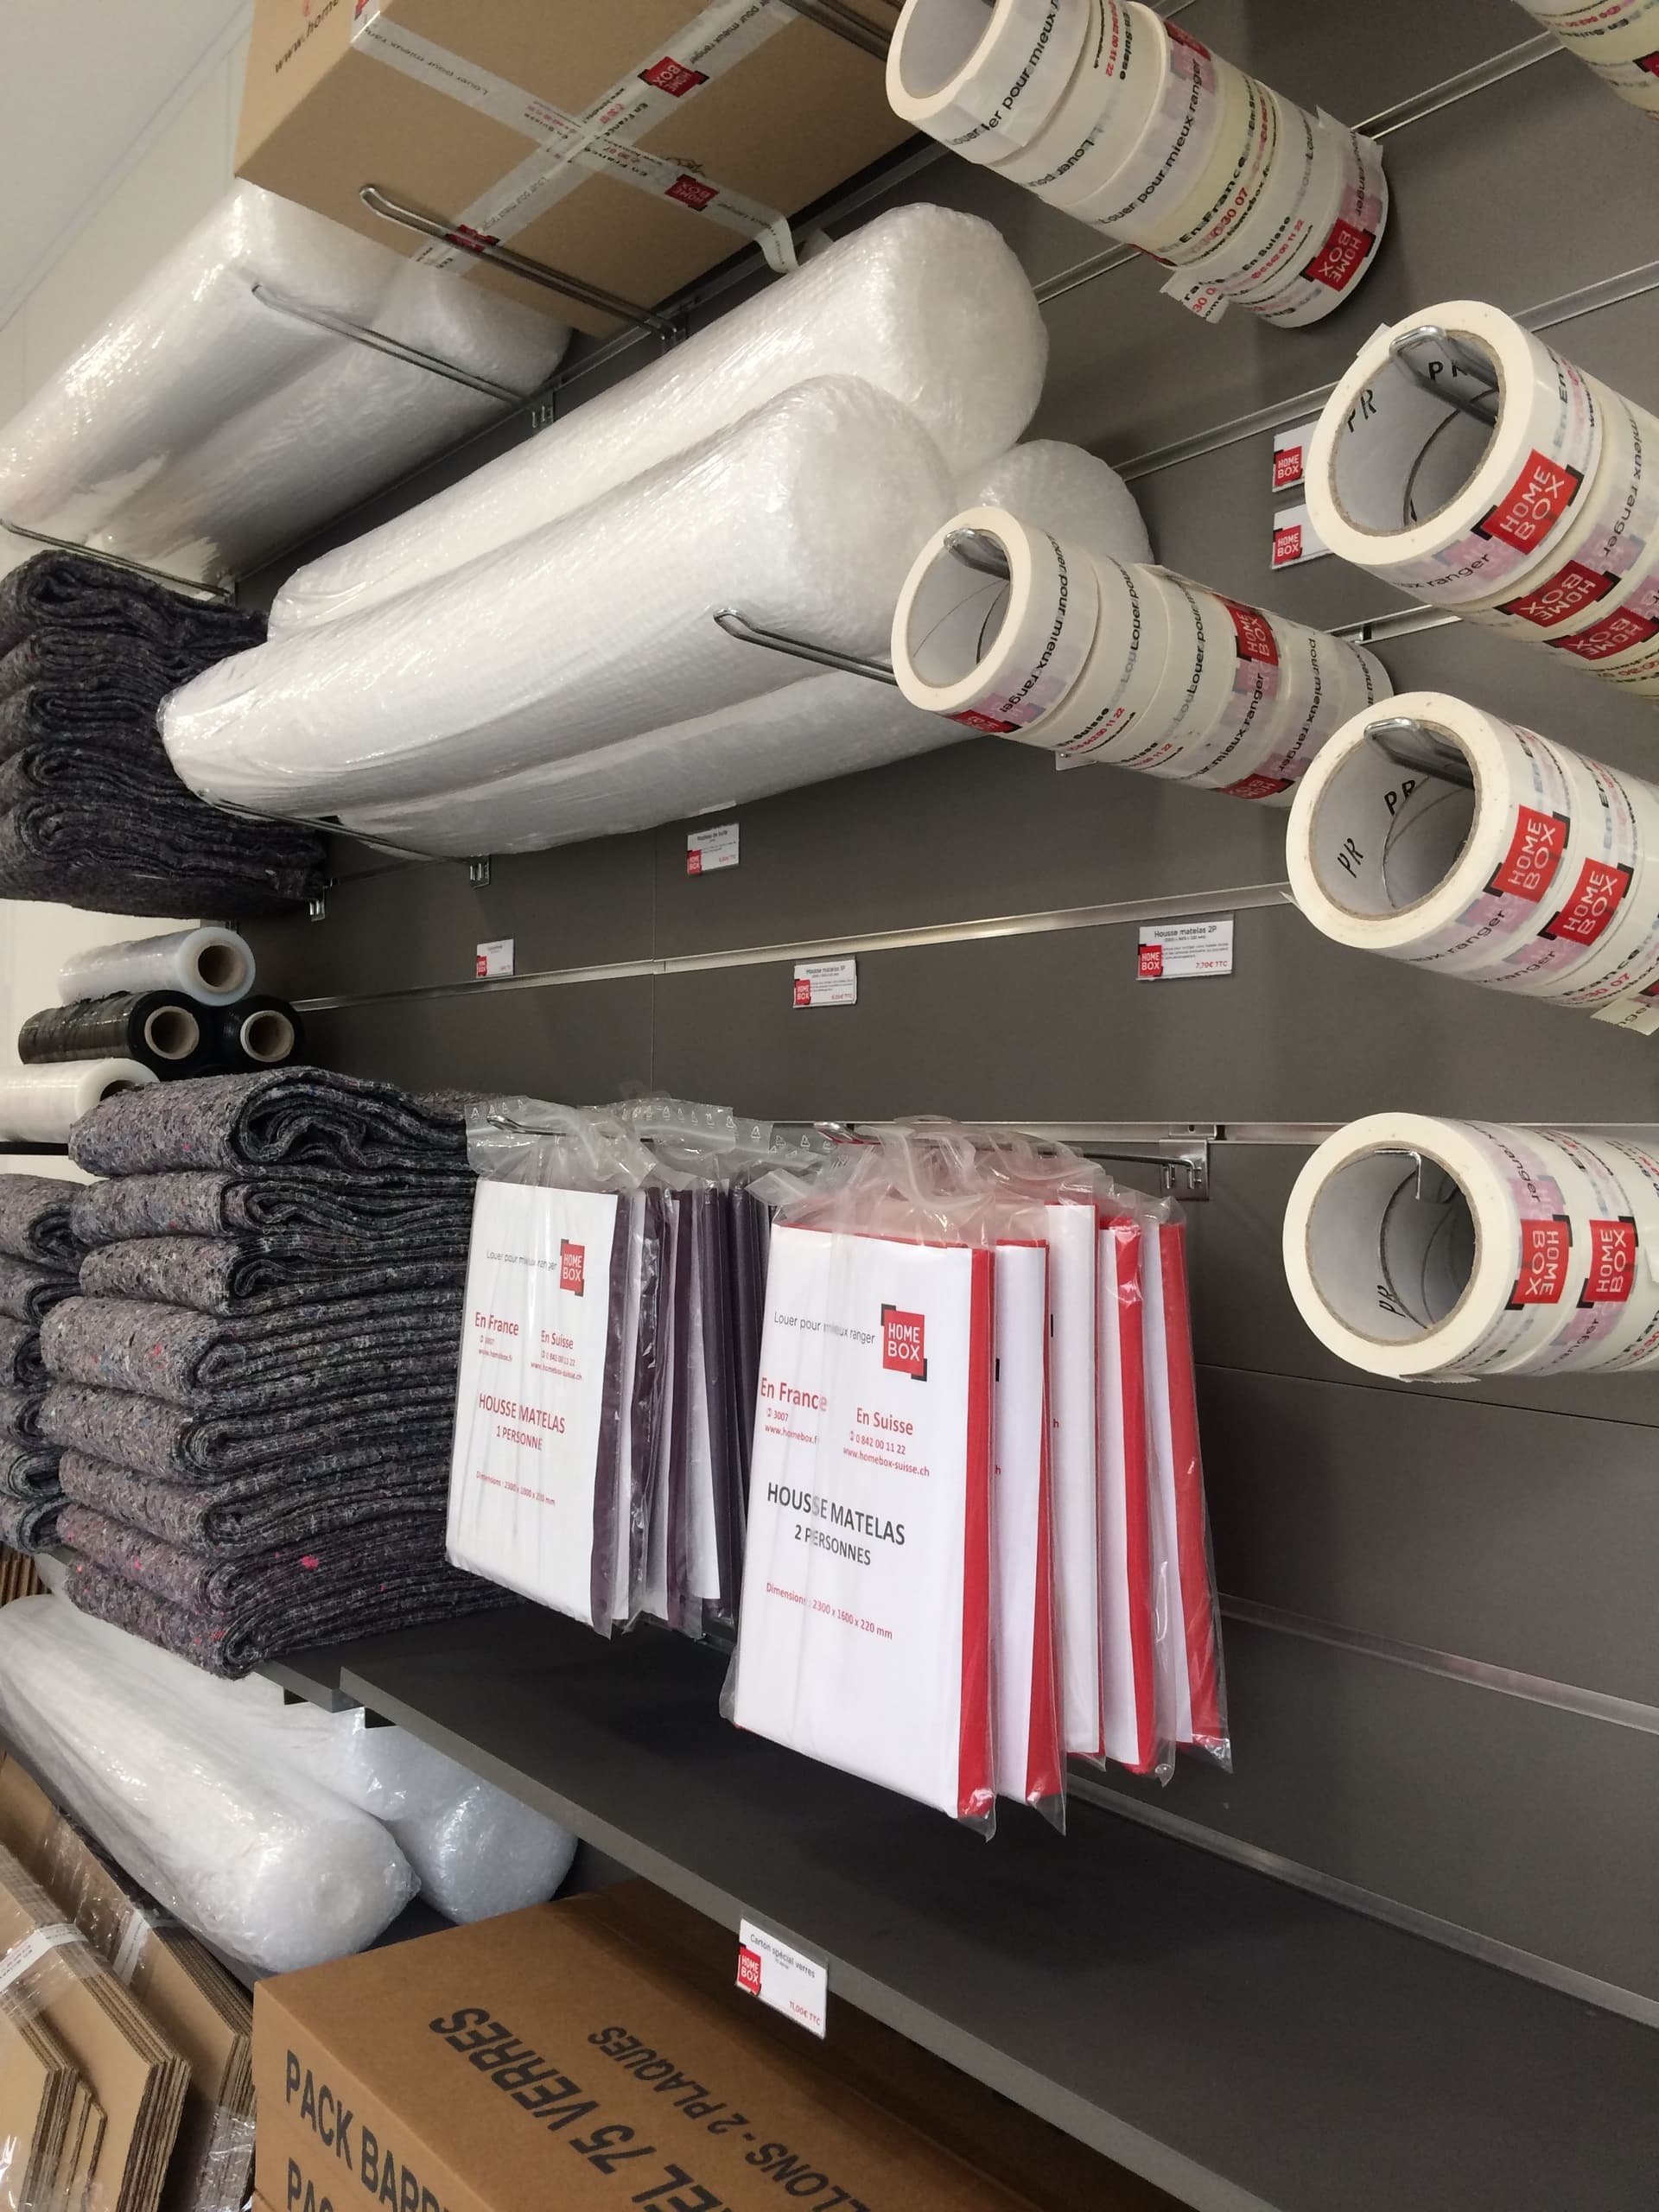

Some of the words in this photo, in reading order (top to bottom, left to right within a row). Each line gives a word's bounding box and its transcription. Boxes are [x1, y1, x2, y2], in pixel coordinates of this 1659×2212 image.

[1002, 67, 1030, 110] pour
[1028, 12, 1056, 67] mieux
[1137, 169, 1166, 204] pour
[1166, 115, 1194, 168] mieux
[1189, 58, 1204, 113] ranger
[1235, 187, 1249, 206] 07
[1317, 230, 1353, 278] BOX
[1332, 238, 1363, 283] HOME
[1278, 454, 1300, 470] HOME
[1278, 464, 1300, 480] BOX
[1500, 465, 1552, 532] HOME
[1515, 474, 1565, 542] BOX
[1277, 533, 1300, 548] HOME
[1603, 486, 1639, 557] ranger
[1277, 542, 1300, 556] BOX
[1427, 552, 1491, 588] ranger
[1058, 574, 1069, 617] pour
[1519, 573, 1580, 615] BOX
[1534, 579, 1596, 622] HOME
[1037, 619, 1064, 671] mieux
[1131, 601, 1141, 651] Louer
[1236, 613, 1260, 653] HOME
[1252, 616, 1271, 658] BOX
[1567, 618, 1631, 650] BOX
[1584, 624, 1644, 656] HOME
[1186, 646, 1205, 695] Louer
[1210, 729, 1247, 768] mieux
[1244, 673, 1263, 725] ranger
[1306, 677, 1323, 723] mieux
[1279, 728, 1309, 772] ranger
[1509, 818, 1543, 887] HOME
[1522, 823, 1557, 892] BOX
[1563, 870, 1607, 931] HOME
[1578, 877, 1618, 937] BOX
[1179, 926, 1206, 936] matelas
[1447, 909, 1507, 956] ranger
[1141, 952, 1160, 962] HOME
[1141, 961, 1161, 971] BOX
[1497, 1142, 1541, 1203] ranger
[563, 1254, 583, 1268] HOME
[563, 1268, 582, 1281] BOX
[1524, 1230, 1546, 1296] BOX
[1540, 1230, 1559, 1296] HOME
[1596, 1229, 1613, 1293] HOME
[1609, 1230, 1626, 1293] BOX
[475, 1312, 486, 1328] En
[488, 1314, 518, 1336] France
[541, 1330, 550, 1343] En
[551, 1332, 574, 1350] Suisse
[774, 1312, 798, 1327] Louer
[800, 1318, 821, 1332] pour
[849, 1328, 876, 1344] ranger
[887, 1322, 920, 1344] HOME
[887, 1340, 920, 1362] BOX
[480, 1393, 517, 1419] HOUSSE
[518, 1404, 566, 1434] MATELAS
[760, 1377, 774, 1398] En
[779, 1382, 828, 1411] France
[773, 1410, 789, 1422] 3007
[856, 1407, 869, 1426] En
[874, 1412, 913, 1436] Suisse
[496, 1425, 501, 1437] 1
[503, 1427, 543, 1451] PERSONNE
[861, 1435, 874, 1447] 842
[875, 1439, 884, 1450] 00
[886, 1441, 894, 1452] 11
[896, 1445, 906, 1455] 22
[842, 1446, 930, 1477] www.homebox-suisse.ch
[767, 1482, 829, 1519] HOUSSE
[830, 1502, 906, 1546] MATELAS
[794, 1524, 802, 1541] 2
[804, 1527, 871, 1566] PERSONNES
[812, 1599, 830, 1615] 2300
[861, 1618, 875, 1633] 220
[876, 1627, 893, 1640] mm
[741, 1955, 760, 1974] HOME
[741, 1966, 759, 1985] BOX
[750, 1934, 771, 1952] Carton
[772, 1947, 794, 1964] spécial
[795, 1961, 815, 1978] verres
[809, 2013, 821, 2025] TTC
[429, 2007, 600, 2133] VERRES
[587, 2025, 727, 2120] PLAQUES
[286, 2049, 353, 2171] PACK
[708, 2112, 751, 2135] 2
[569, 2124, 658, 2175] 75
